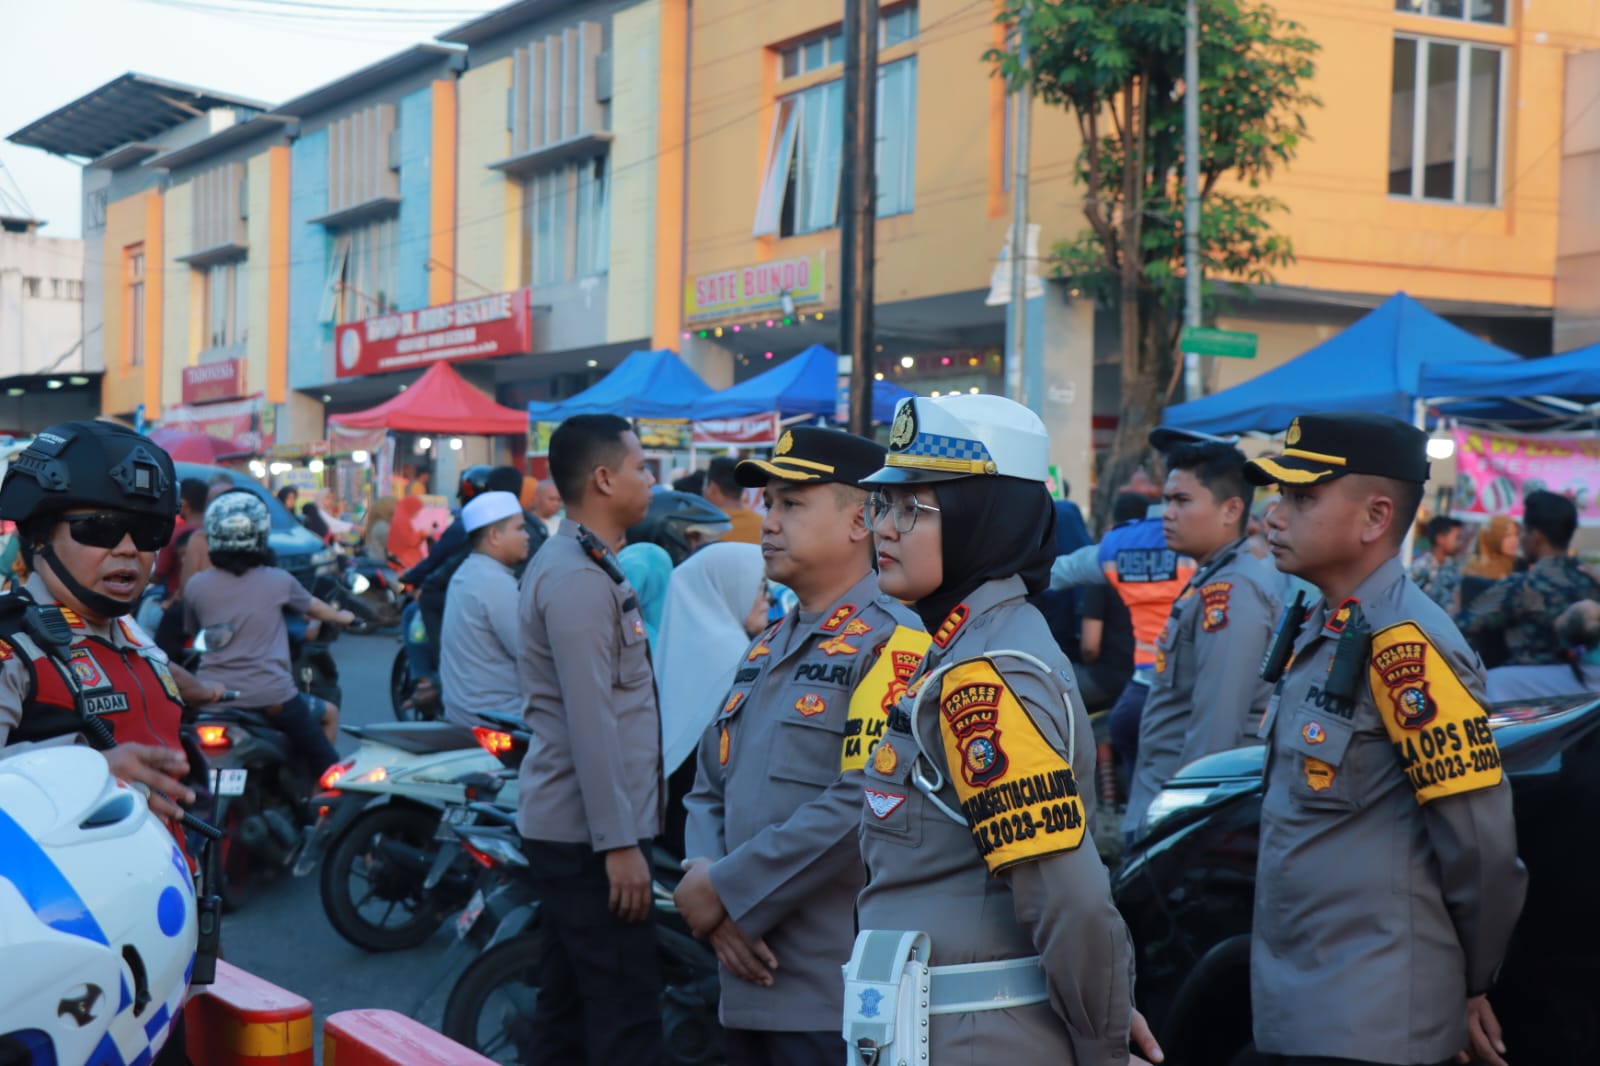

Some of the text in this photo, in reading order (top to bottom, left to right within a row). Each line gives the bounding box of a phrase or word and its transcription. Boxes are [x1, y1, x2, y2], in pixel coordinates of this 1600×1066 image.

[696, 257, 809, 306] SATE BUNDO
[1117, 549, 1176, 576] DISHUB
[1376, 645, 1421, 666] POLRES
[794, 663, 850, 686] POLRI
[1387, 665, 1421, 681] RIAU
[87, 695, 125, 712] DADAN
[946, 687, 995, 712] POLRES
[950, 695, 993, 715] KAMPAR
[956, 712, 992, 730] RIAU
[1420, 723, 1462, 759] OPS
